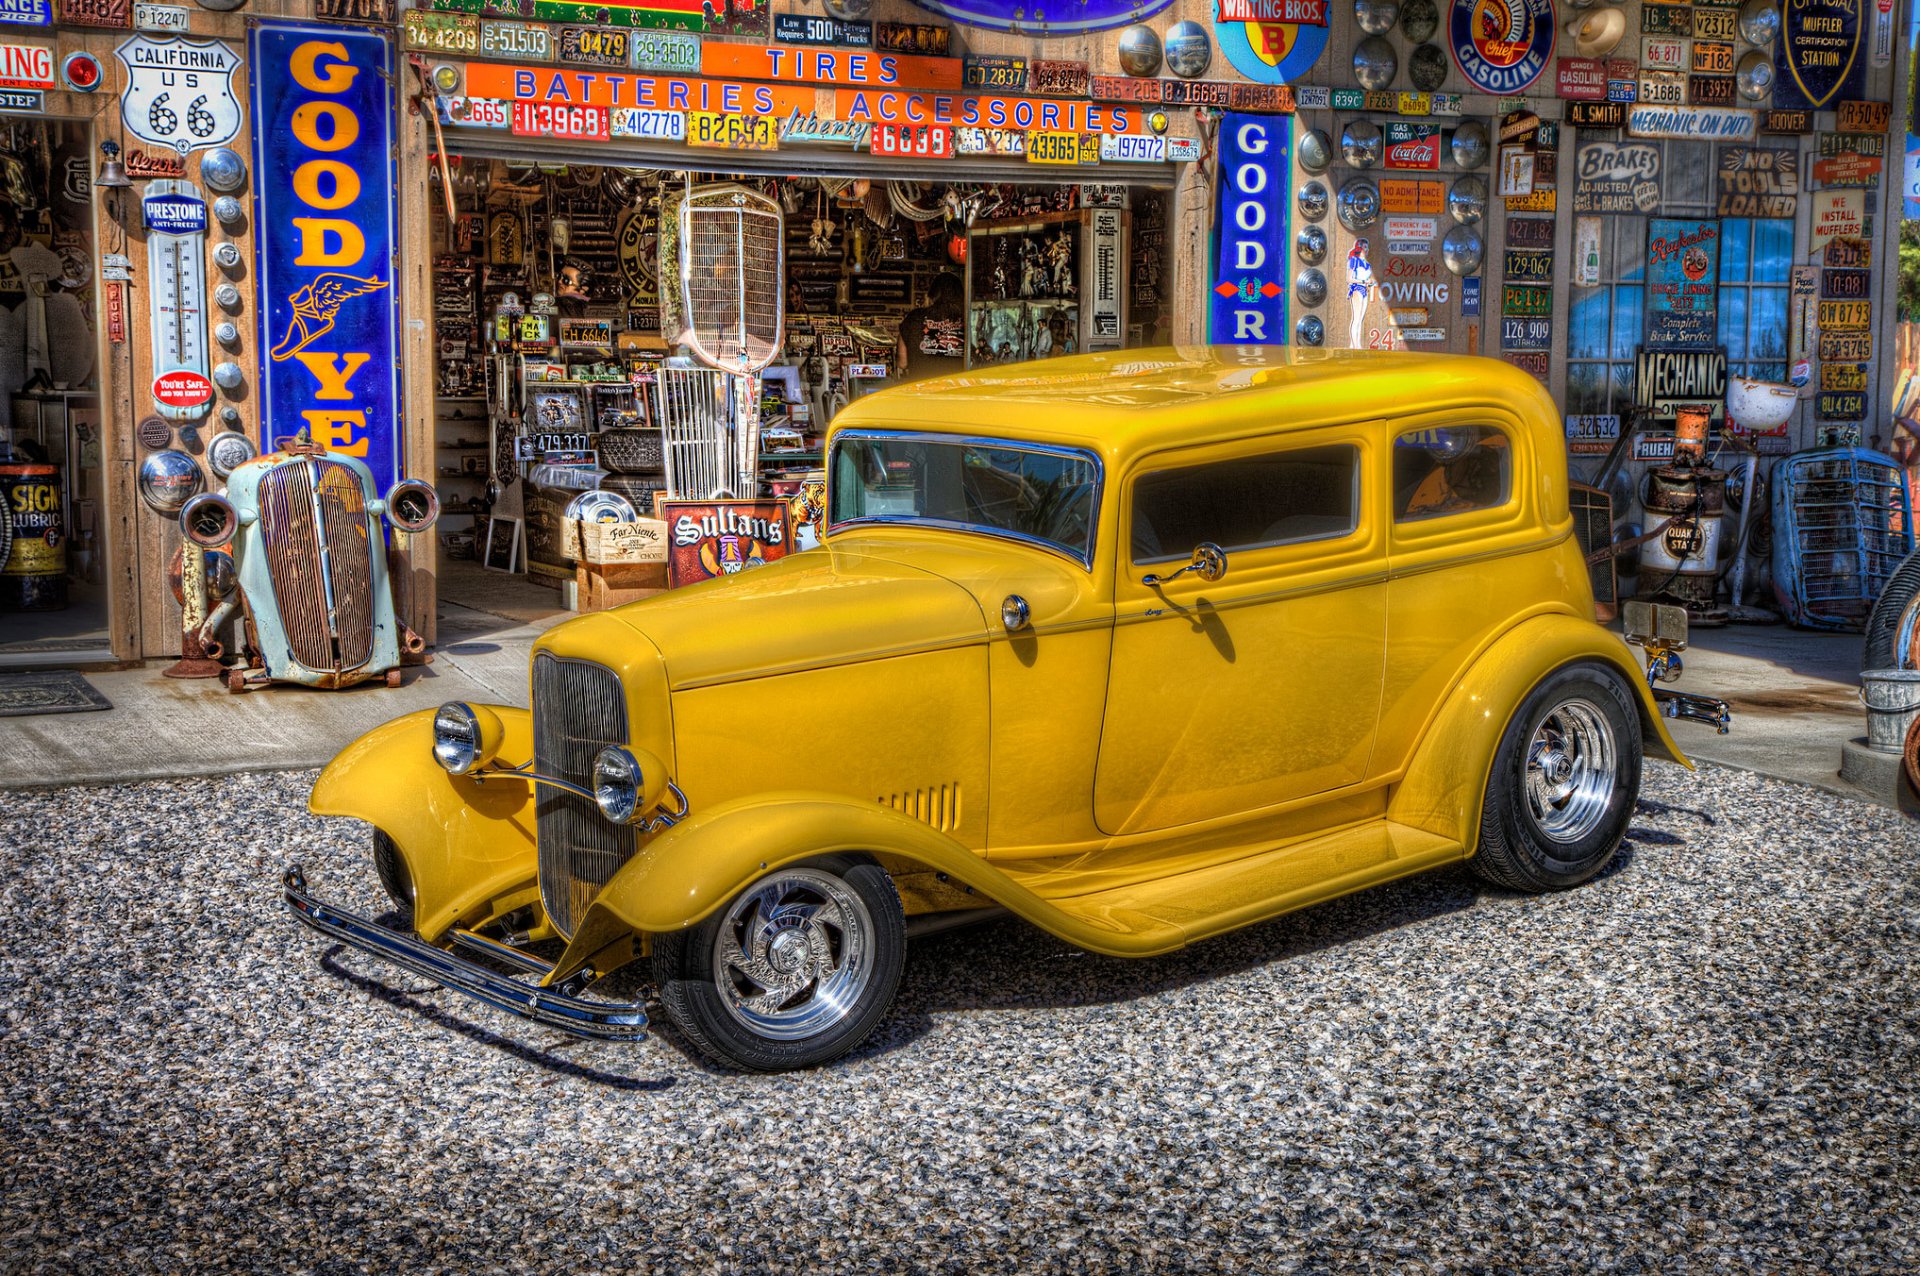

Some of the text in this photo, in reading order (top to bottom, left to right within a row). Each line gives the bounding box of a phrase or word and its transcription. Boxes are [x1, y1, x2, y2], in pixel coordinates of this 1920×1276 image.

[151, 11, 186, 26] 12247
[1223, 0, 1321, 19] WHITING BROS.
[783, 18, 800, 27] Law
[807, 20, 833, 41] 500
[843, 23, 871, 33] Between
[1695, 17, 1735, 35] V2312
[1803, 17, 1843, 33] MUFFLER
[777, 28, 804, 40] Requires
[846, 34, 868, 43] Trucks
[1262, 26, 1285, 54] B
[1795, 36, 1848, 47] CERTIFICATION
[134, 47, 225, 68] CALIFORNIA
[637, 41, 695, 66] 29-3503
[1485, 40, 1527, 64] Chief
[1802, 50, 1840, 66] STATION
[767, 50, 899, 83] TIRES
[1459, 44, 1542, 88] GASOLINE
[990, 68, 1022, 86] 2837
[1560, 71, 1604, 85] GASOLINE
[514, 70, 773, 113] BATTERIES
[149, 92, 215, 137] 66
[524, 104, 599, 136] 113968
[848, 92, 1128, 132] ACCESSORIES
[1572, 105, 1621, 123] AL SMITH
[1768, 113, 1805, 129] HOOVER
[628, 111, 680, 136] 412778
[782, 105, 868, 152] Liberty
[1393, 123, 1408, 131] GAS
[1630, 111, 1751, 135] MECHANIC ON DUTY
[1390, 132, 1412, 140] TODAY
[962, 143, 974, 151] CAL
[1030, 135, 1075, 161] 43365
[1105, 149, 1117, 157] CAL
[1118, 137, 1163, 159] 197972
[1581, 147, 1657, 177] BRAKES
[1743, 151, 1774, 169] NO
[1578, 176, 1636, 193] ADJUSTED!
[1719, 170, 1798, 195] TOOLS
[1383, 187, 1440, 197] NO ADMITTANCE
[1640, 194, 1658, 206] NOW
[146, 202, 203, 220] PRESTONE
[1602, 195, 1634, 211] BRAKES
[1717, 195, 1797, 217] LOANED
[1832, 197, 1846, 208] WE
[152, 220, 198, 228] ANTI-FREEZE
[1821, 210, 1856, 222] INSTALL
[1815, 223, 1861, 236] MUFFLERS
[1390, 243, 1430, 252] NO ADMITTANCE
[1383, 256, 1438, 278] Dave's
[1369, 282, 1449, 303] TOWING
[1651, 283, 1712, 295] BRAKE LINING
[110, 290, 120, 332] PUSH
[1504, 321, 1549, 339] 126 909
[1661, 317, 1701, 330] Complete
[1369, 329, 1393, 350] 24
[1650, 330, 1712, 342] Brake Service
[1637, 353, 1726, 411] MECHANIC
[609, 524, 660, 541] Far Niente
[675, 506, 783, 547] Sultans
[1668, 527, 1701, 538] QUAKR
[1671, 540, 1697, 550] STAE
